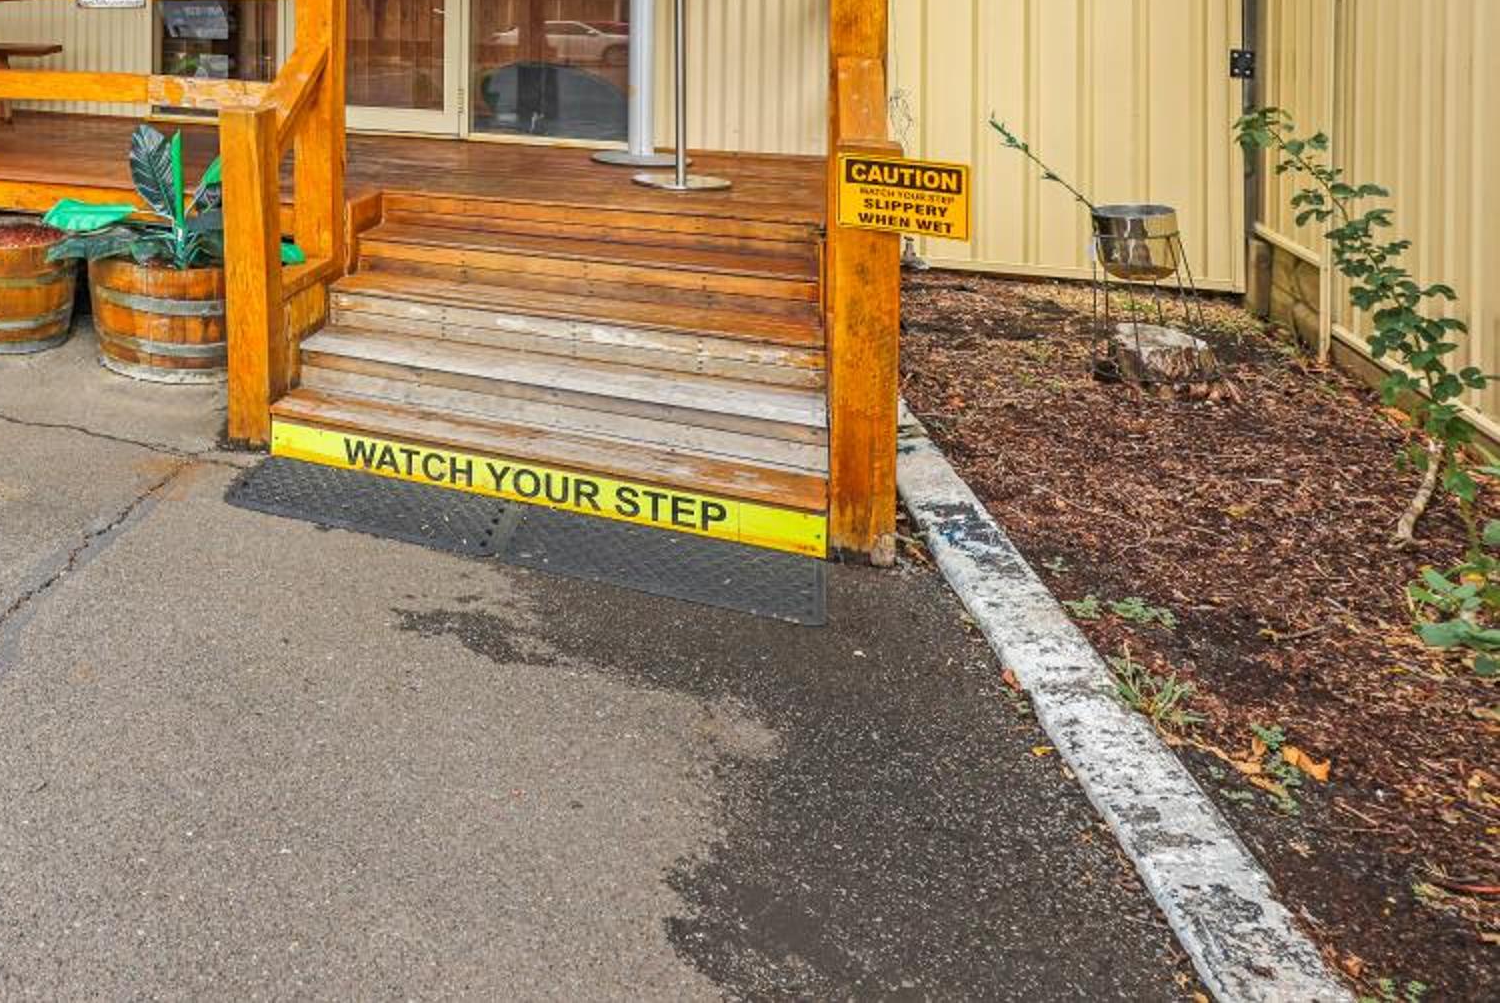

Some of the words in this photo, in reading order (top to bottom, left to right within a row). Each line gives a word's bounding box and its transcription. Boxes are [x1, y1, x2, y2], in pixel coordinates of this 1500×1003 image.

[850, 163, 958, 191] CAUTION
[859, 187, 895, 198] WATCH
[897, 191, 925, 201] YOUR
[928, 195, 955, 204] STEP
[863, 198, 948, 218] SLIPPERY
[857, 212, 911, 228] WHEN
[915, 218, 955, 234] WET
[344, 437, 473, 488] WATCH
[486, 462, 601, 513] YOUR
[615, 485, 728, 532] STEP
